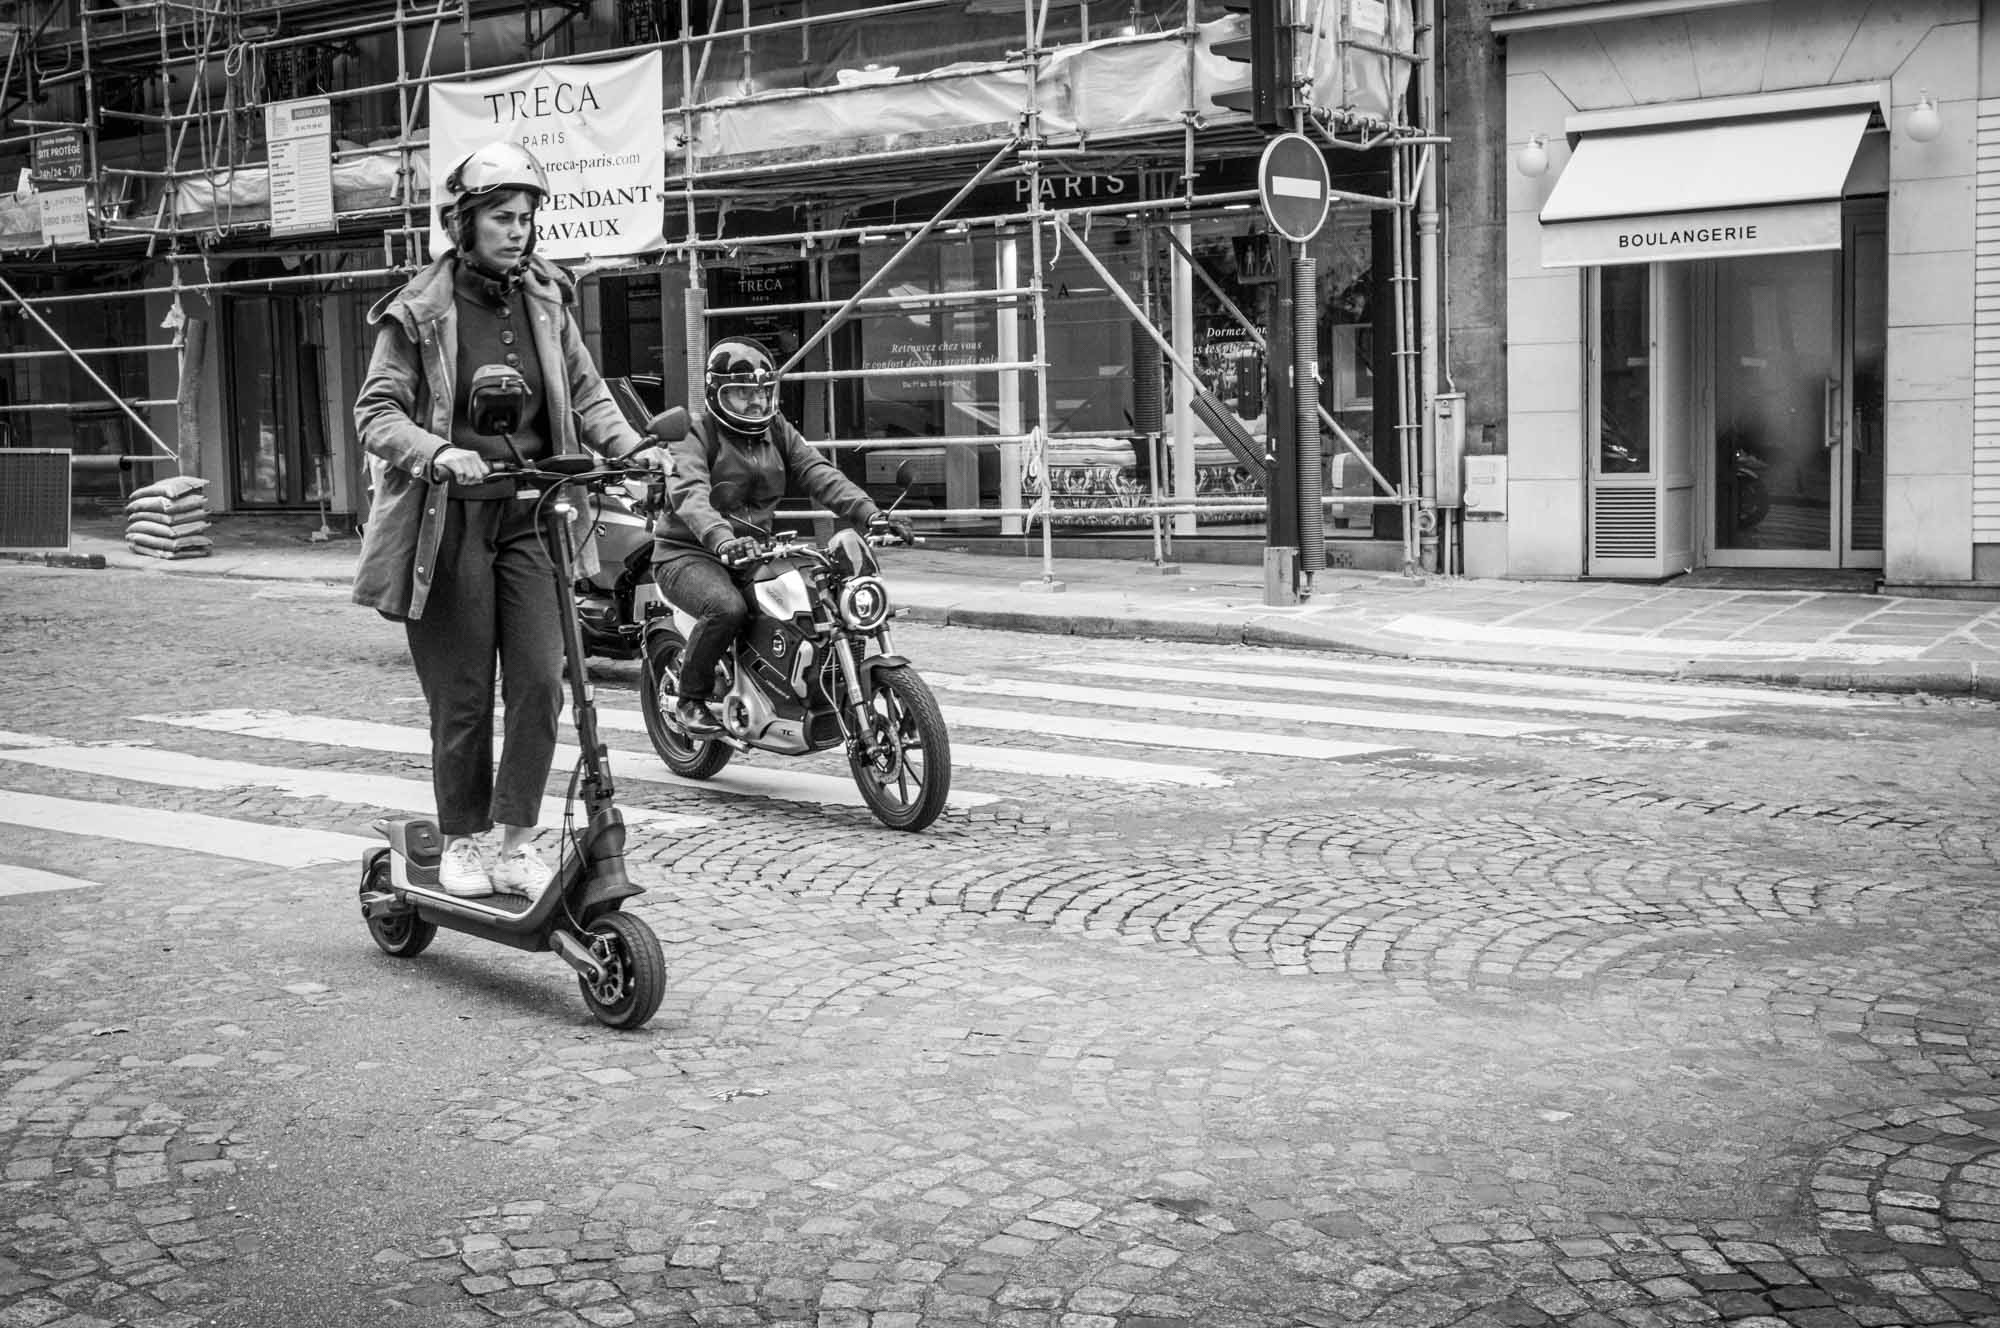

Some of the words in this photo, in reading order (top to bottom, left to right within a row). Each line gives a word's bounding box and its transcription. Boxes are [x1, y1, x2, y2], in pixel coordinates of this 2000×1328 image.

[484, 82, 601, 124] TRECA
[522, 132, 566, 147] PARIS
[540, 185, 652, 211] PENDANT
[1016, 175, 1125, 202] PARIS
[536, 218, 621, 242] RAVAUX
[1619, 225, 1758, 248] BOULANGERIE
[738, 279, 783, 293] TRECA
[1207, 327, 1247, 337] Dormez
[891, 343, 936, 353] Retrouvez
[938, 341, 958, 351] chez
[960, 341, 983, 351] vous
[872, 360, 904, 369] confort
